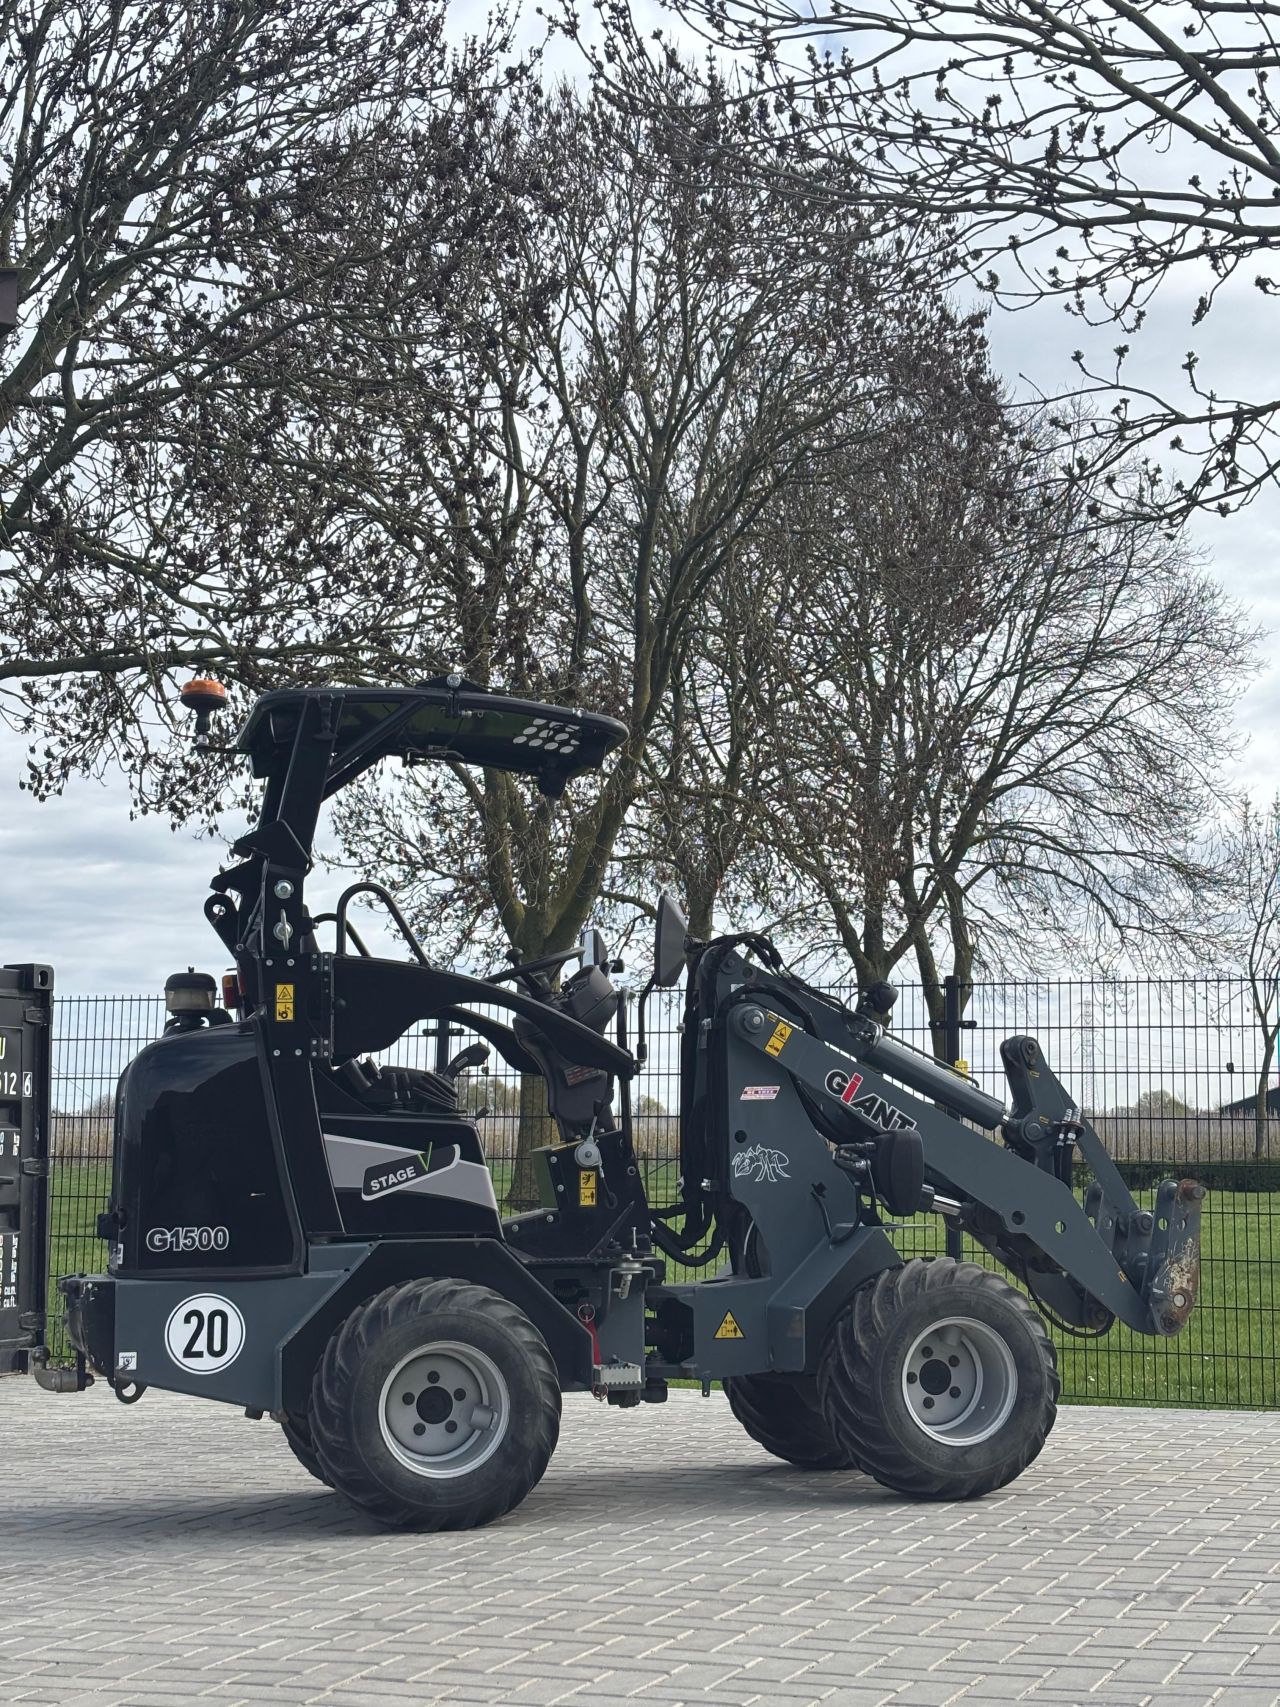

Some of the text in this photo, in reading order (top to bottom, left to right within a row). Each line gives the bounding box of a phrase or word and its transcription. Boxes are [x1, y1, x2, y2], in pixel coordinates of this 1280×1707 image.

[0, 1072, 17, 1095] 12
[370, 1166, 417, 1191] STAGE
[146, 1226, 230, 1252] G1500
[182, 1309, 229, 1358] 20
